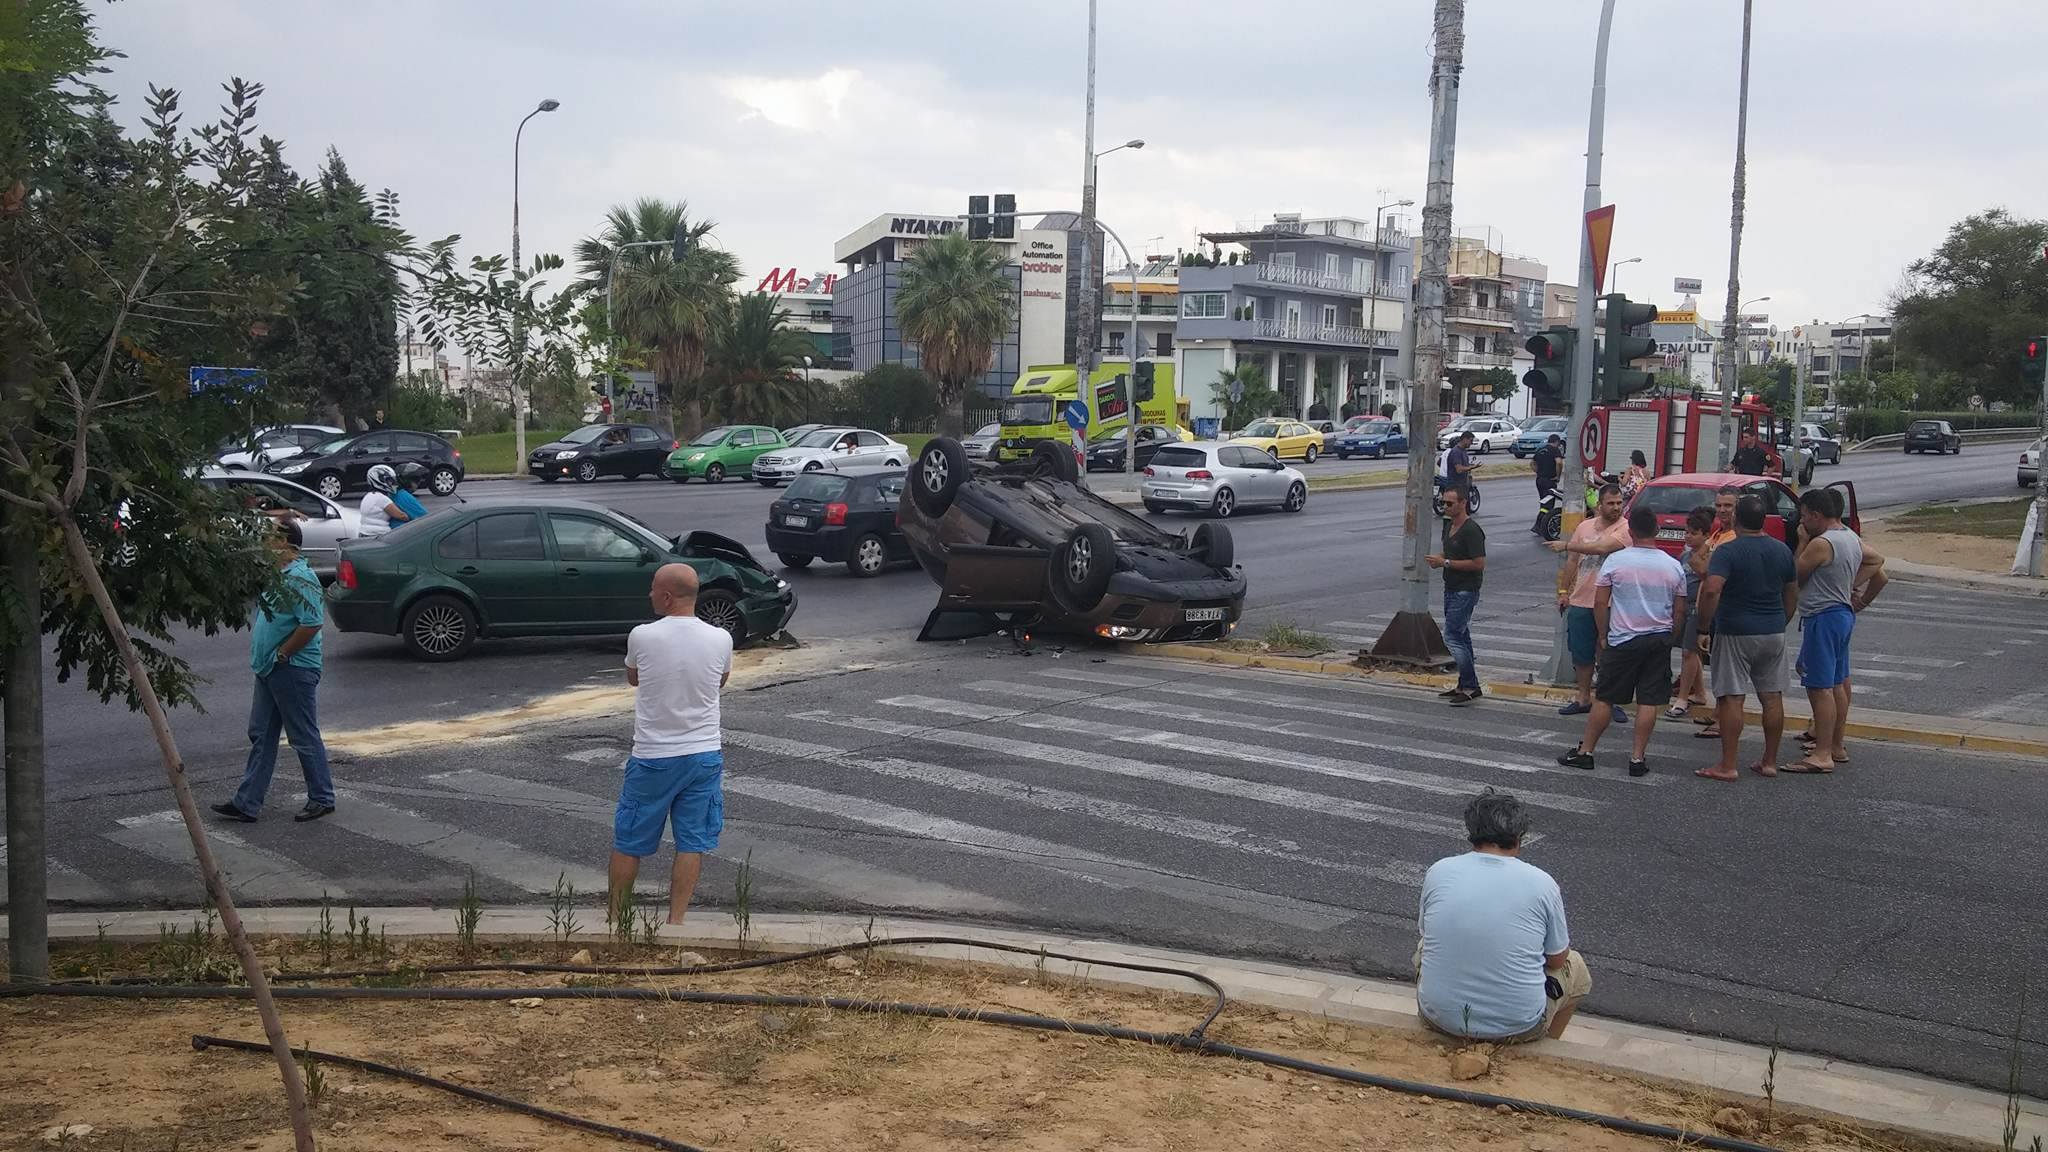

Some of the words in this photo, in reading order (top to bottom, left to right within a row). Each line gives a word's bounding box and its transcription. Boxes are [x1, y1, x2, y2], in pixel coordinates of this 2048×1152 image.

[1031, 241, 1054, 250] Office
[1022, 250, 1064, 259] Automation
[1022, 261, 1064, 273] brother
